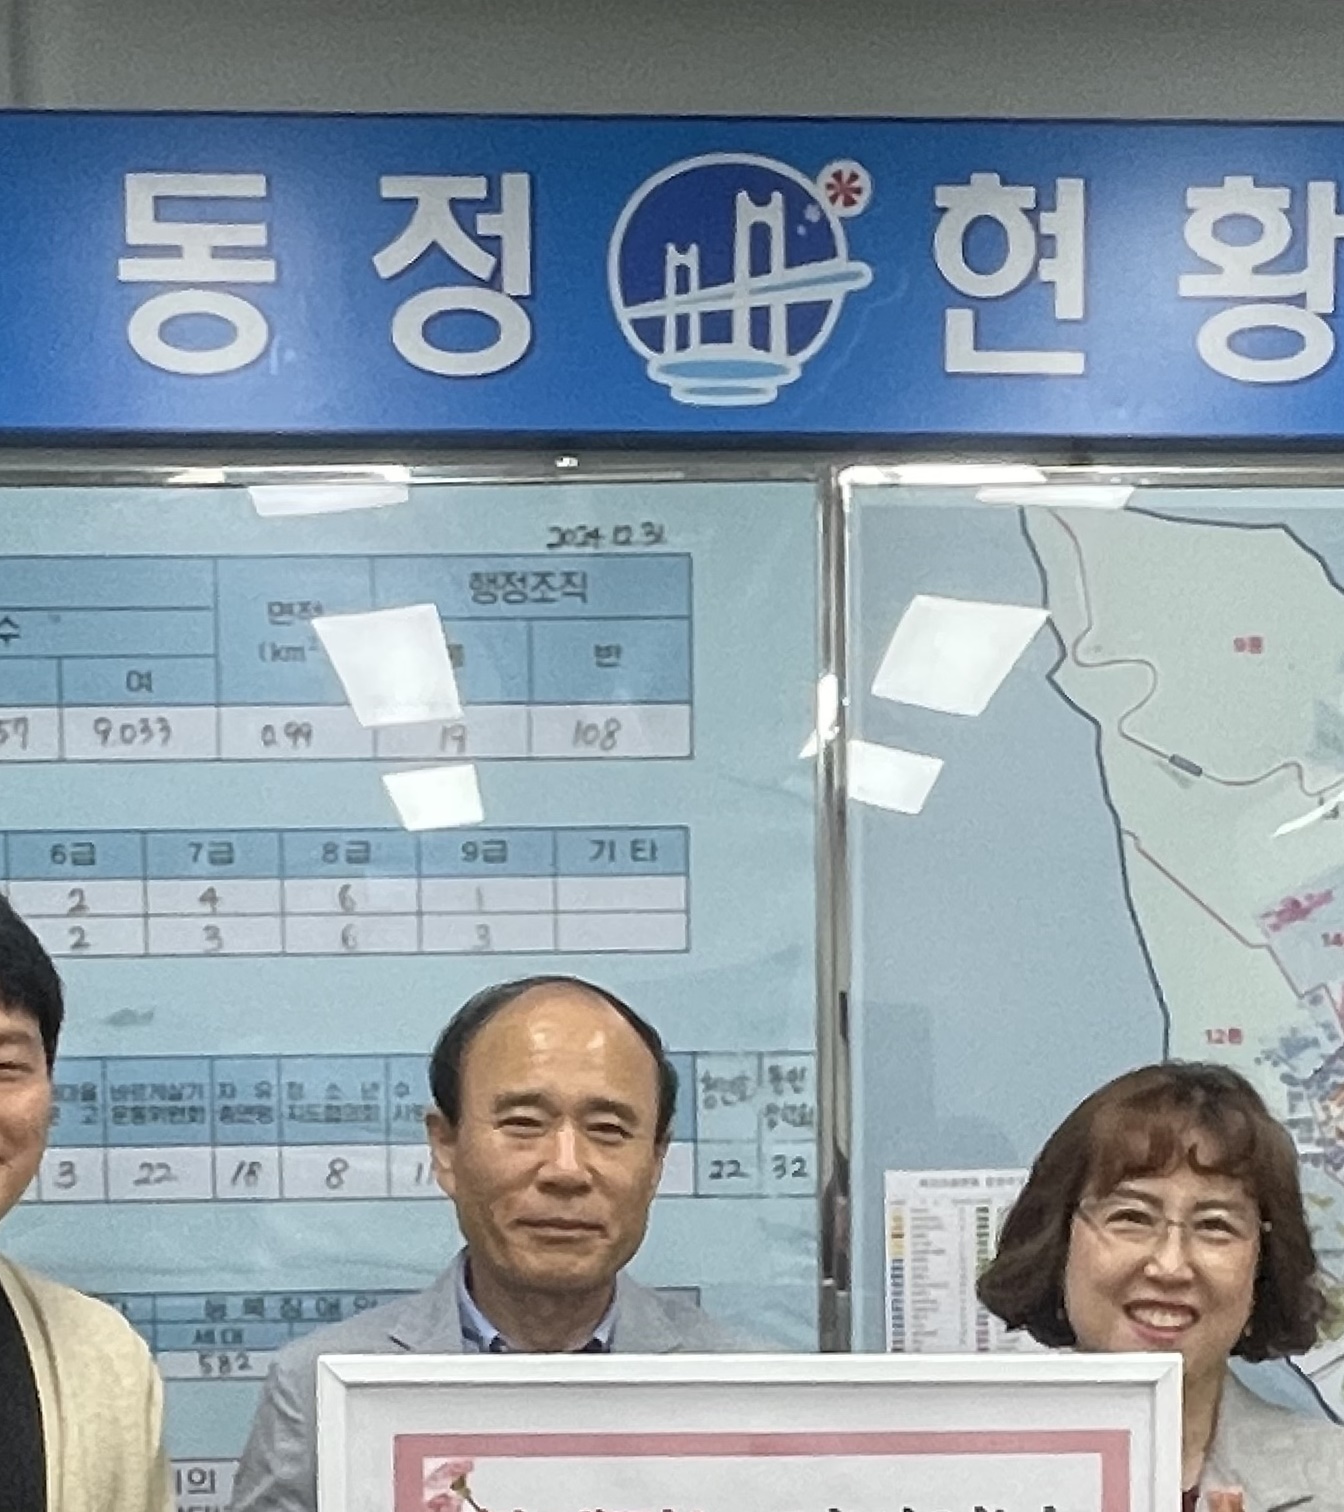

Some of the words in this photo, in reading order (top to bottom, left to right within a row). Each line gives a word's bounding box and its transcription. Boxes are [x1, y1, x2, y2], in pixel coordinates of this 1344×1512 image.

[468, 571, 589, 604] 행정조직
[125, 669, 154, 694] 여
[572, 717, 621, 748] 108
[50, 840, 97, 867] 6급
[187, 840, 236, 866] 7급
[322, 839, 372, 866] 8급
[460, 839, 510, 865] 9급
[66, 888, 89, 917] 2
[197, 885, 221, 914] 4
[337, 883, 356, 913] 6
[68, 926, 92, 951] 2
[200, 924, 224, 953] 3
[132, 1161, 178, 1187] 22
[324, 1157, 351, 1190] 8
[708, 1158, 751, 1181] 22
[771, 1153, 809, 1180] 32
